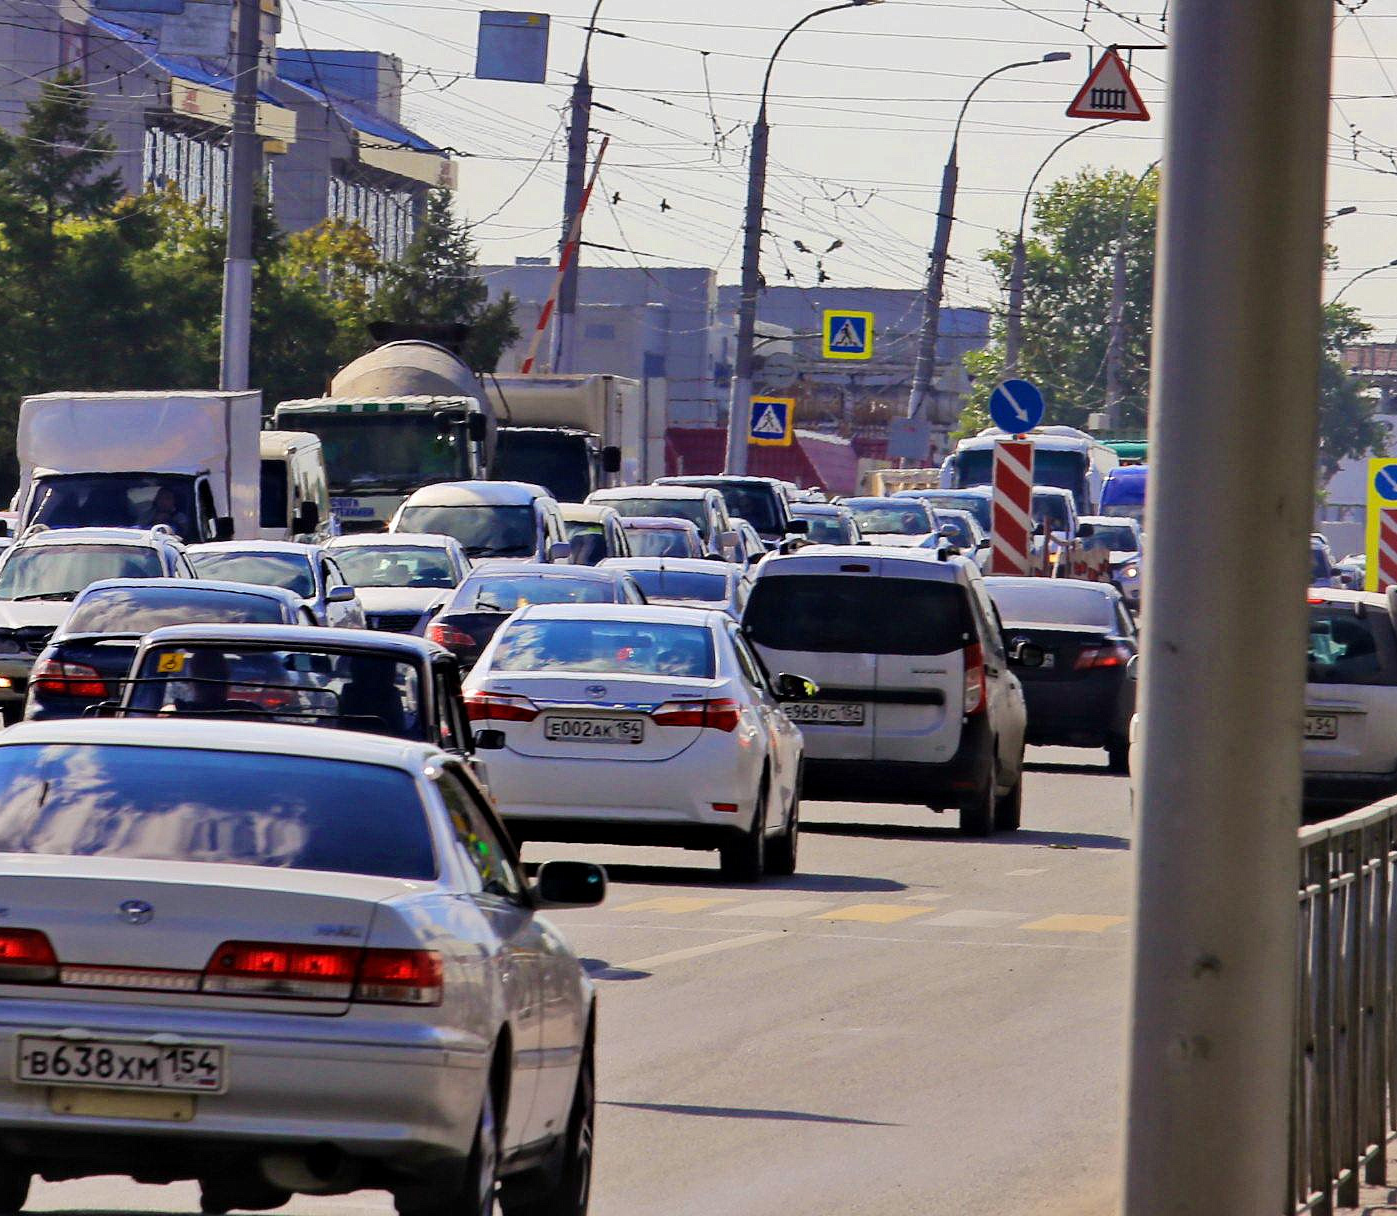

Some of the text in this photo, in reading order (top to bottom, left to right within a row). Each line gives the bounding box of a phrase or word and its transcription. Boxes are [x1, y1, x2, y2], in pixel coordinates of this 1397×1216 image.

[551, 720, 640, 737] Е002АК 154
[30, 1045, 217, 1081] В638ХМ 154
